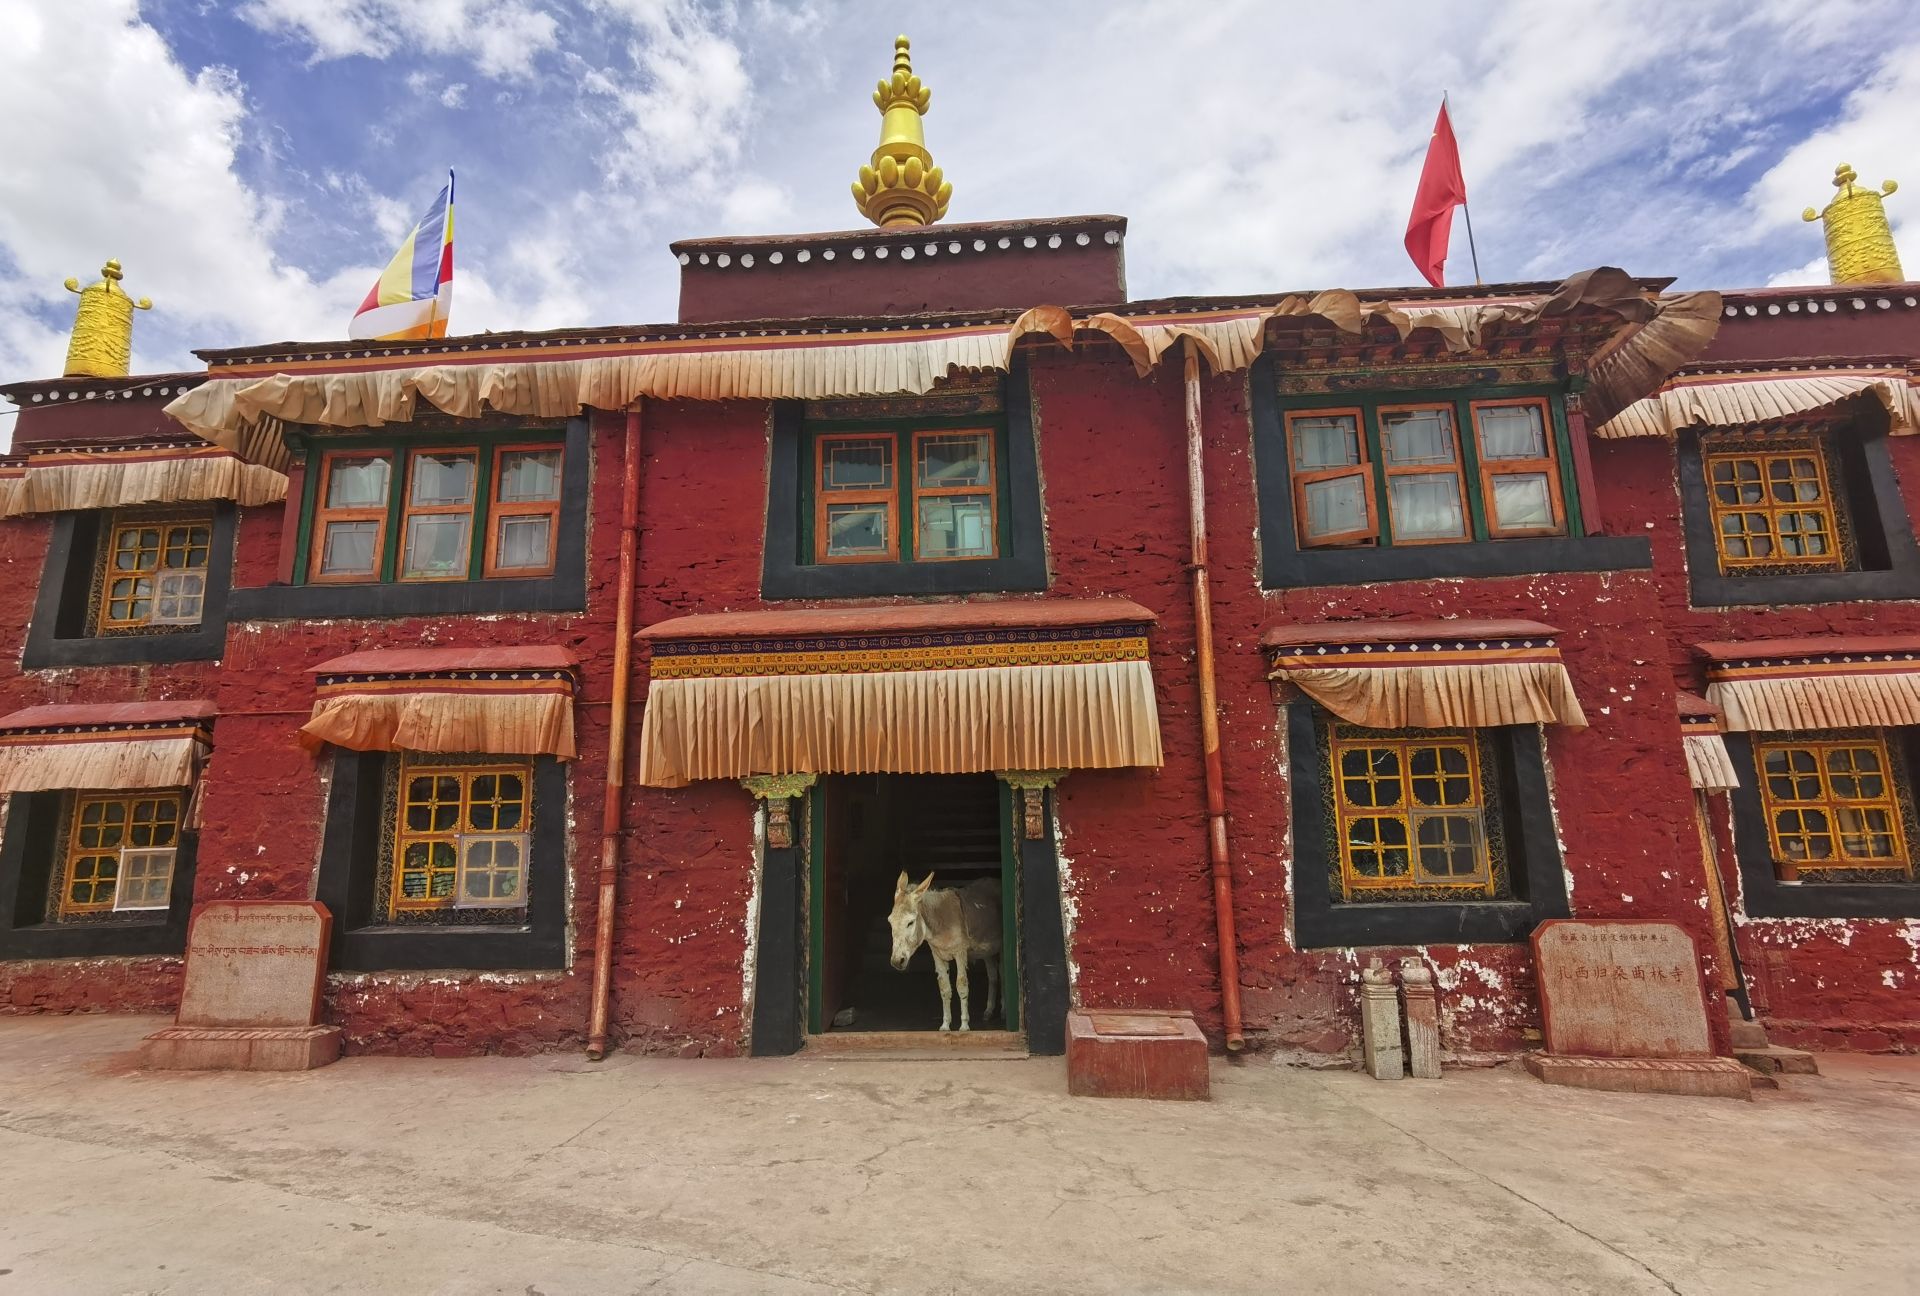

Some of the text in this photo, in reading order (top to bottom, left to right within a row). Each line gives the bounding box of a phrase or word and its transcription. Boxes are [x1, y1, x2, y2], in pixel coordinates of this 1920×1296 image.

[1560, 933, 1669, 942] 西藏自治区文物保护单位
[1558, 965, 1684, 982] 扎西归桑曲林寺
